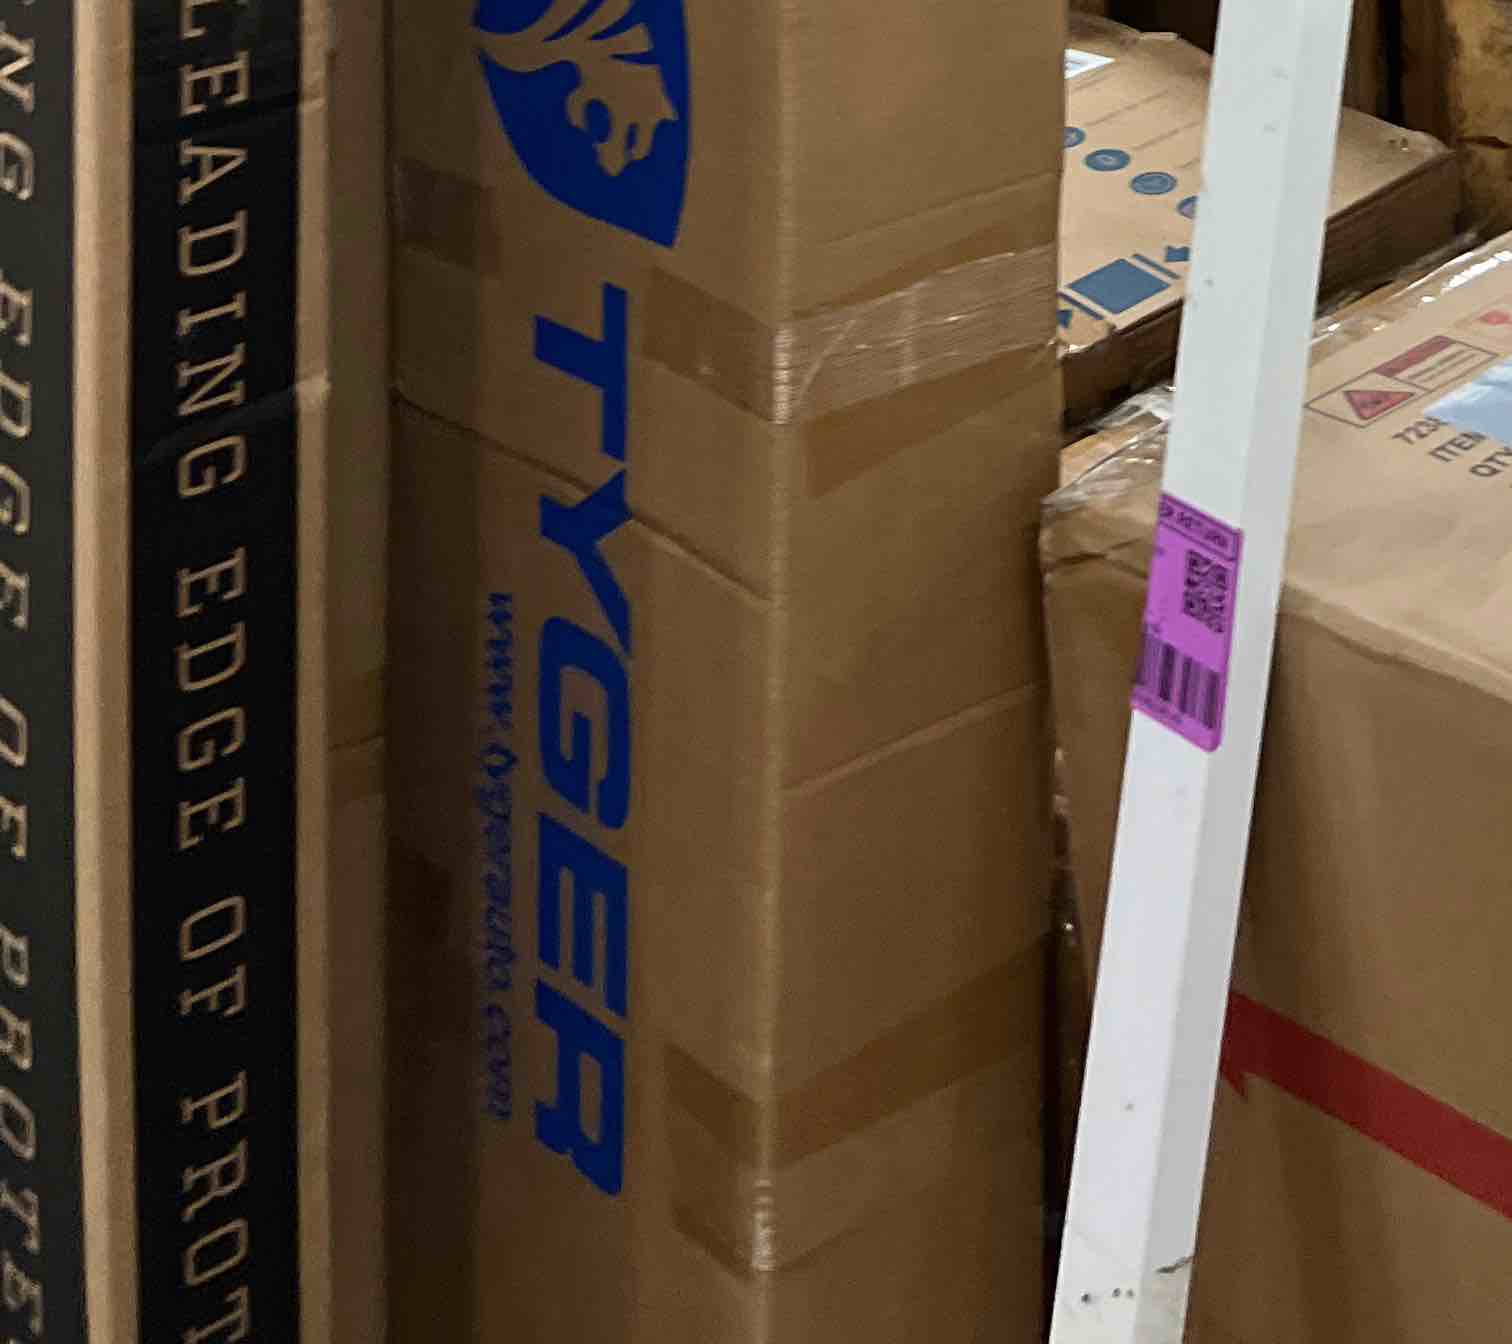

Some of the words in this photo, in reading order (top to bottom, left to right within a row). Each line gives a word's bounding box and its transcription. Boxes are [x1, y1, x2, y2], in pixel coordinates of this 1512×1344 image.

[176, 547, 247, 853] EDGE
[533, 290, 633, 1199] TYGER
[178, 894, 246, 1020] OF
